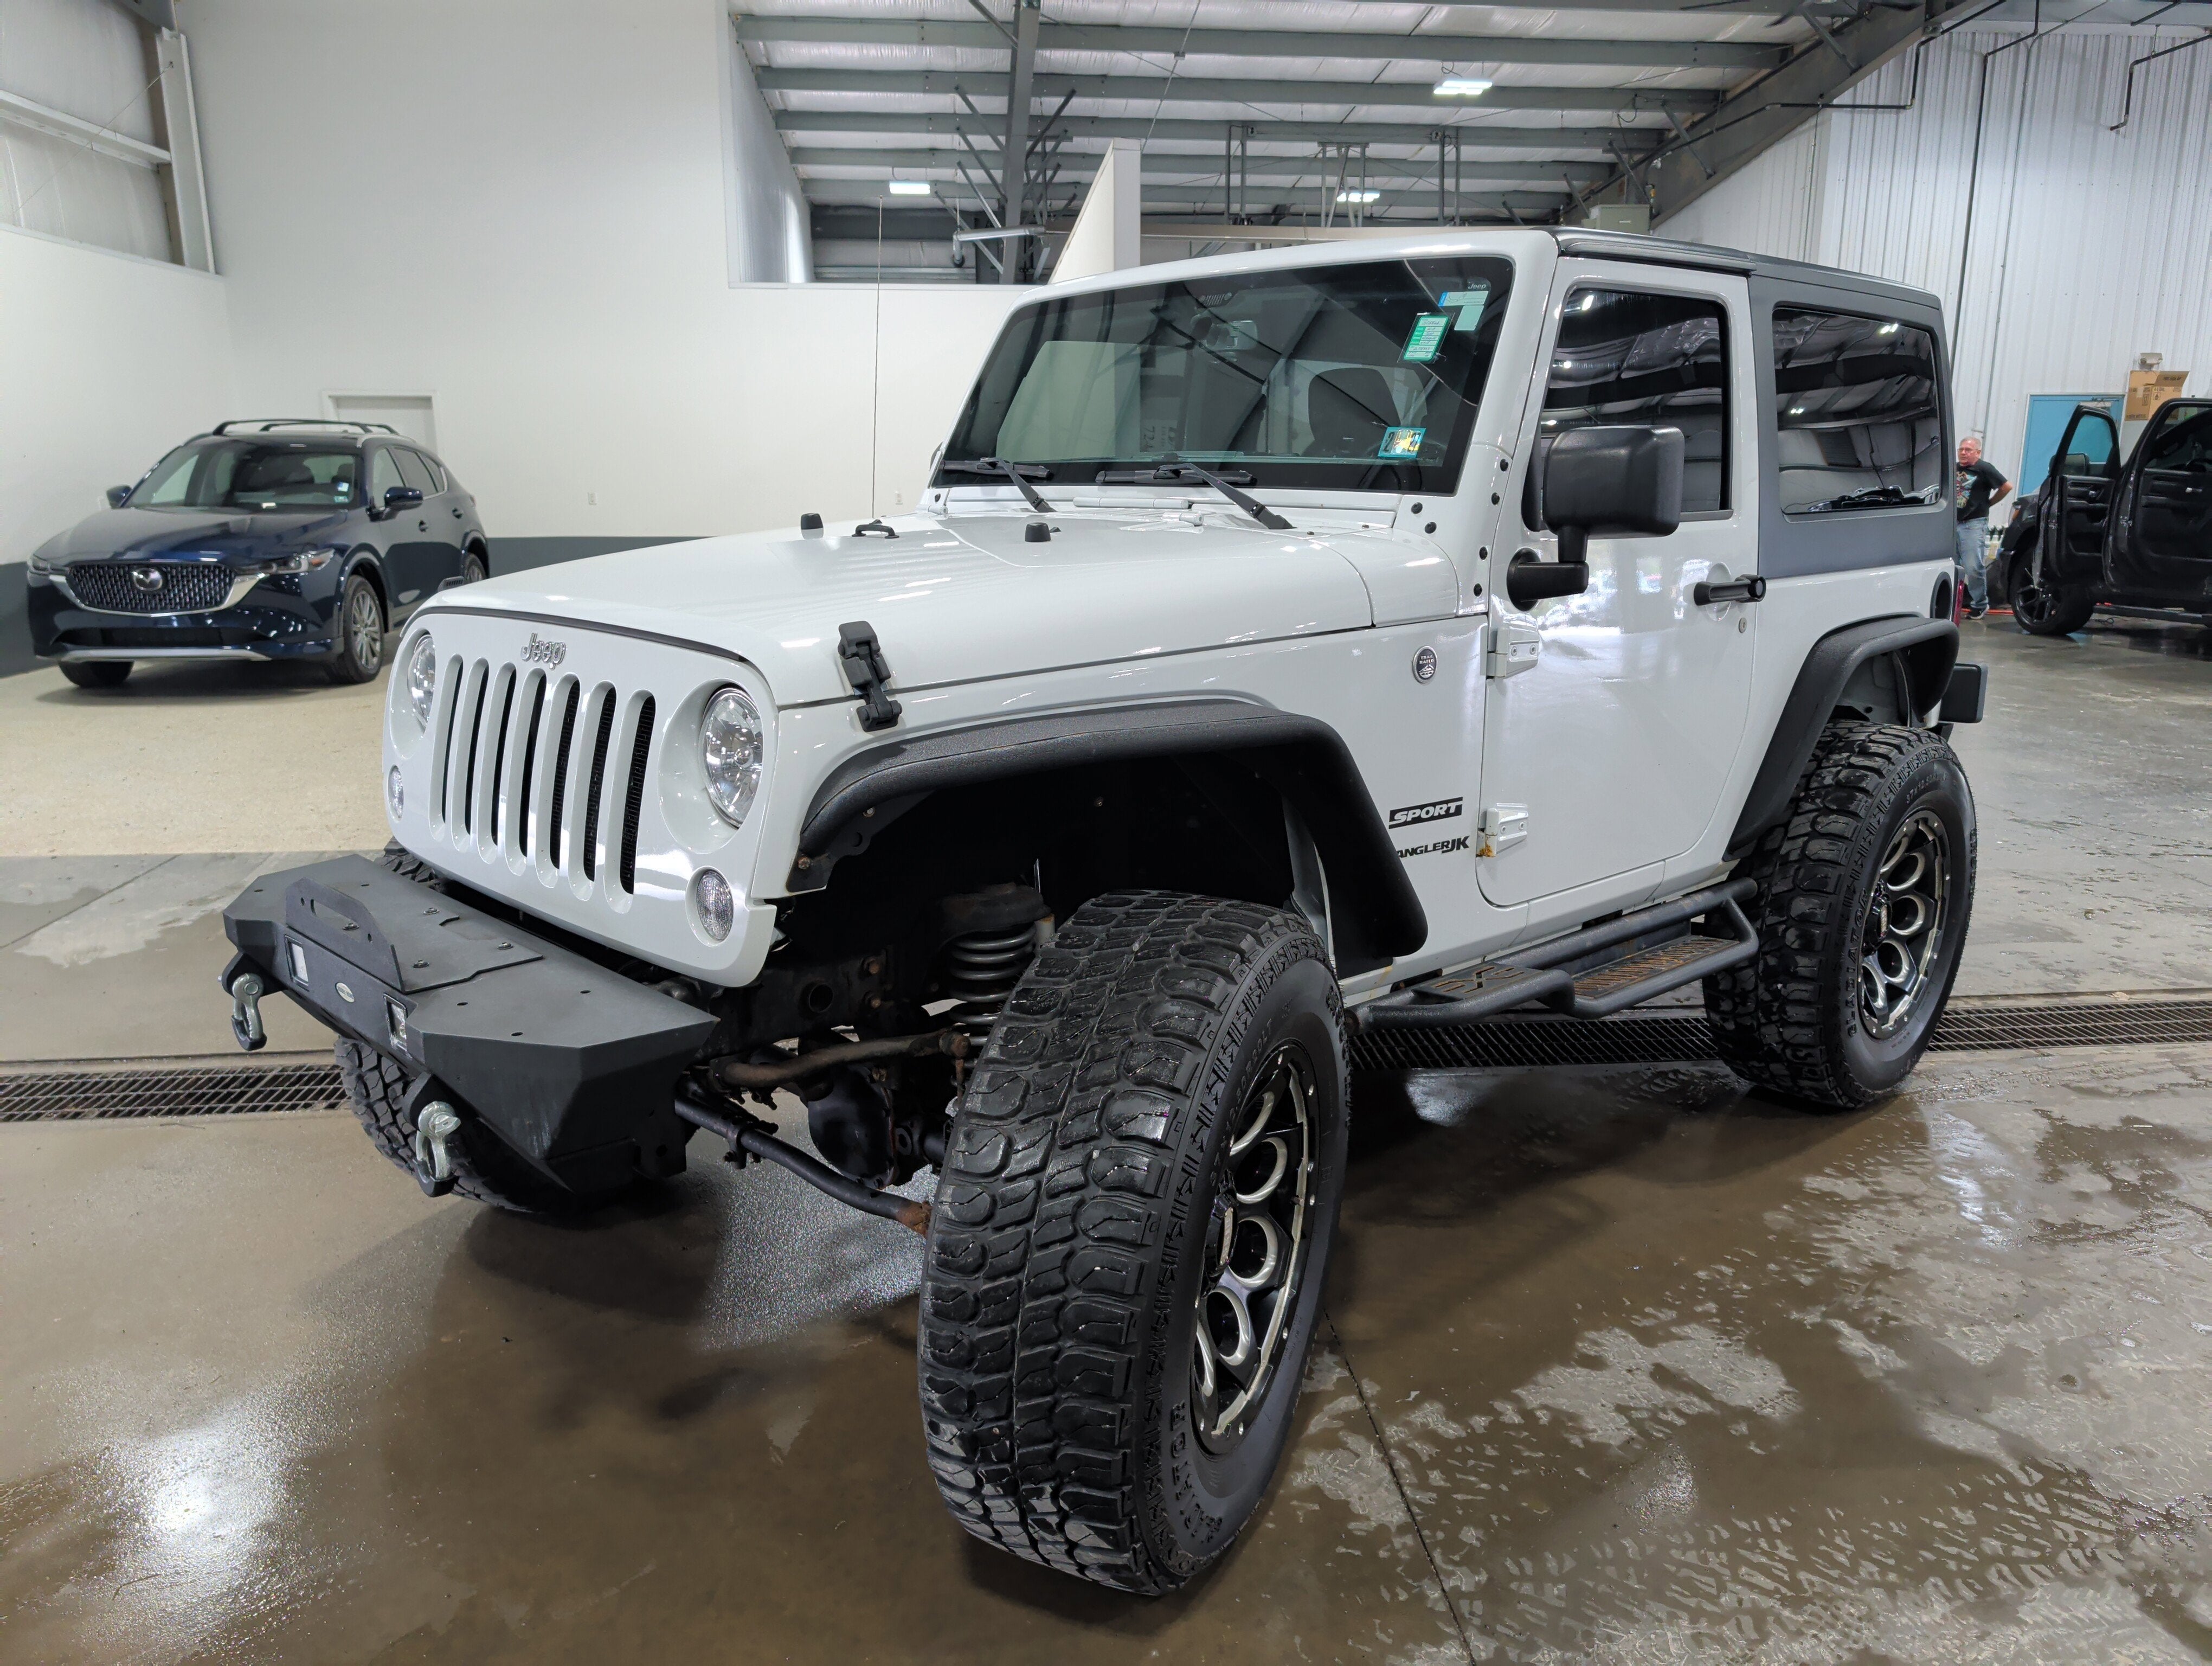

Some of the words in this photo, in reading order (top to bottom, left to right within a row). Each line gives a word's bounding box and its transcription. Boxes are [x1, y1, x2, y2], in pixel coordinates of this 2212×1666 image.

[1383, 432, 1395, 452] 2
[521, 633, 566, 670] Jeep
[1390, 802, 1462, 824] SPORT
